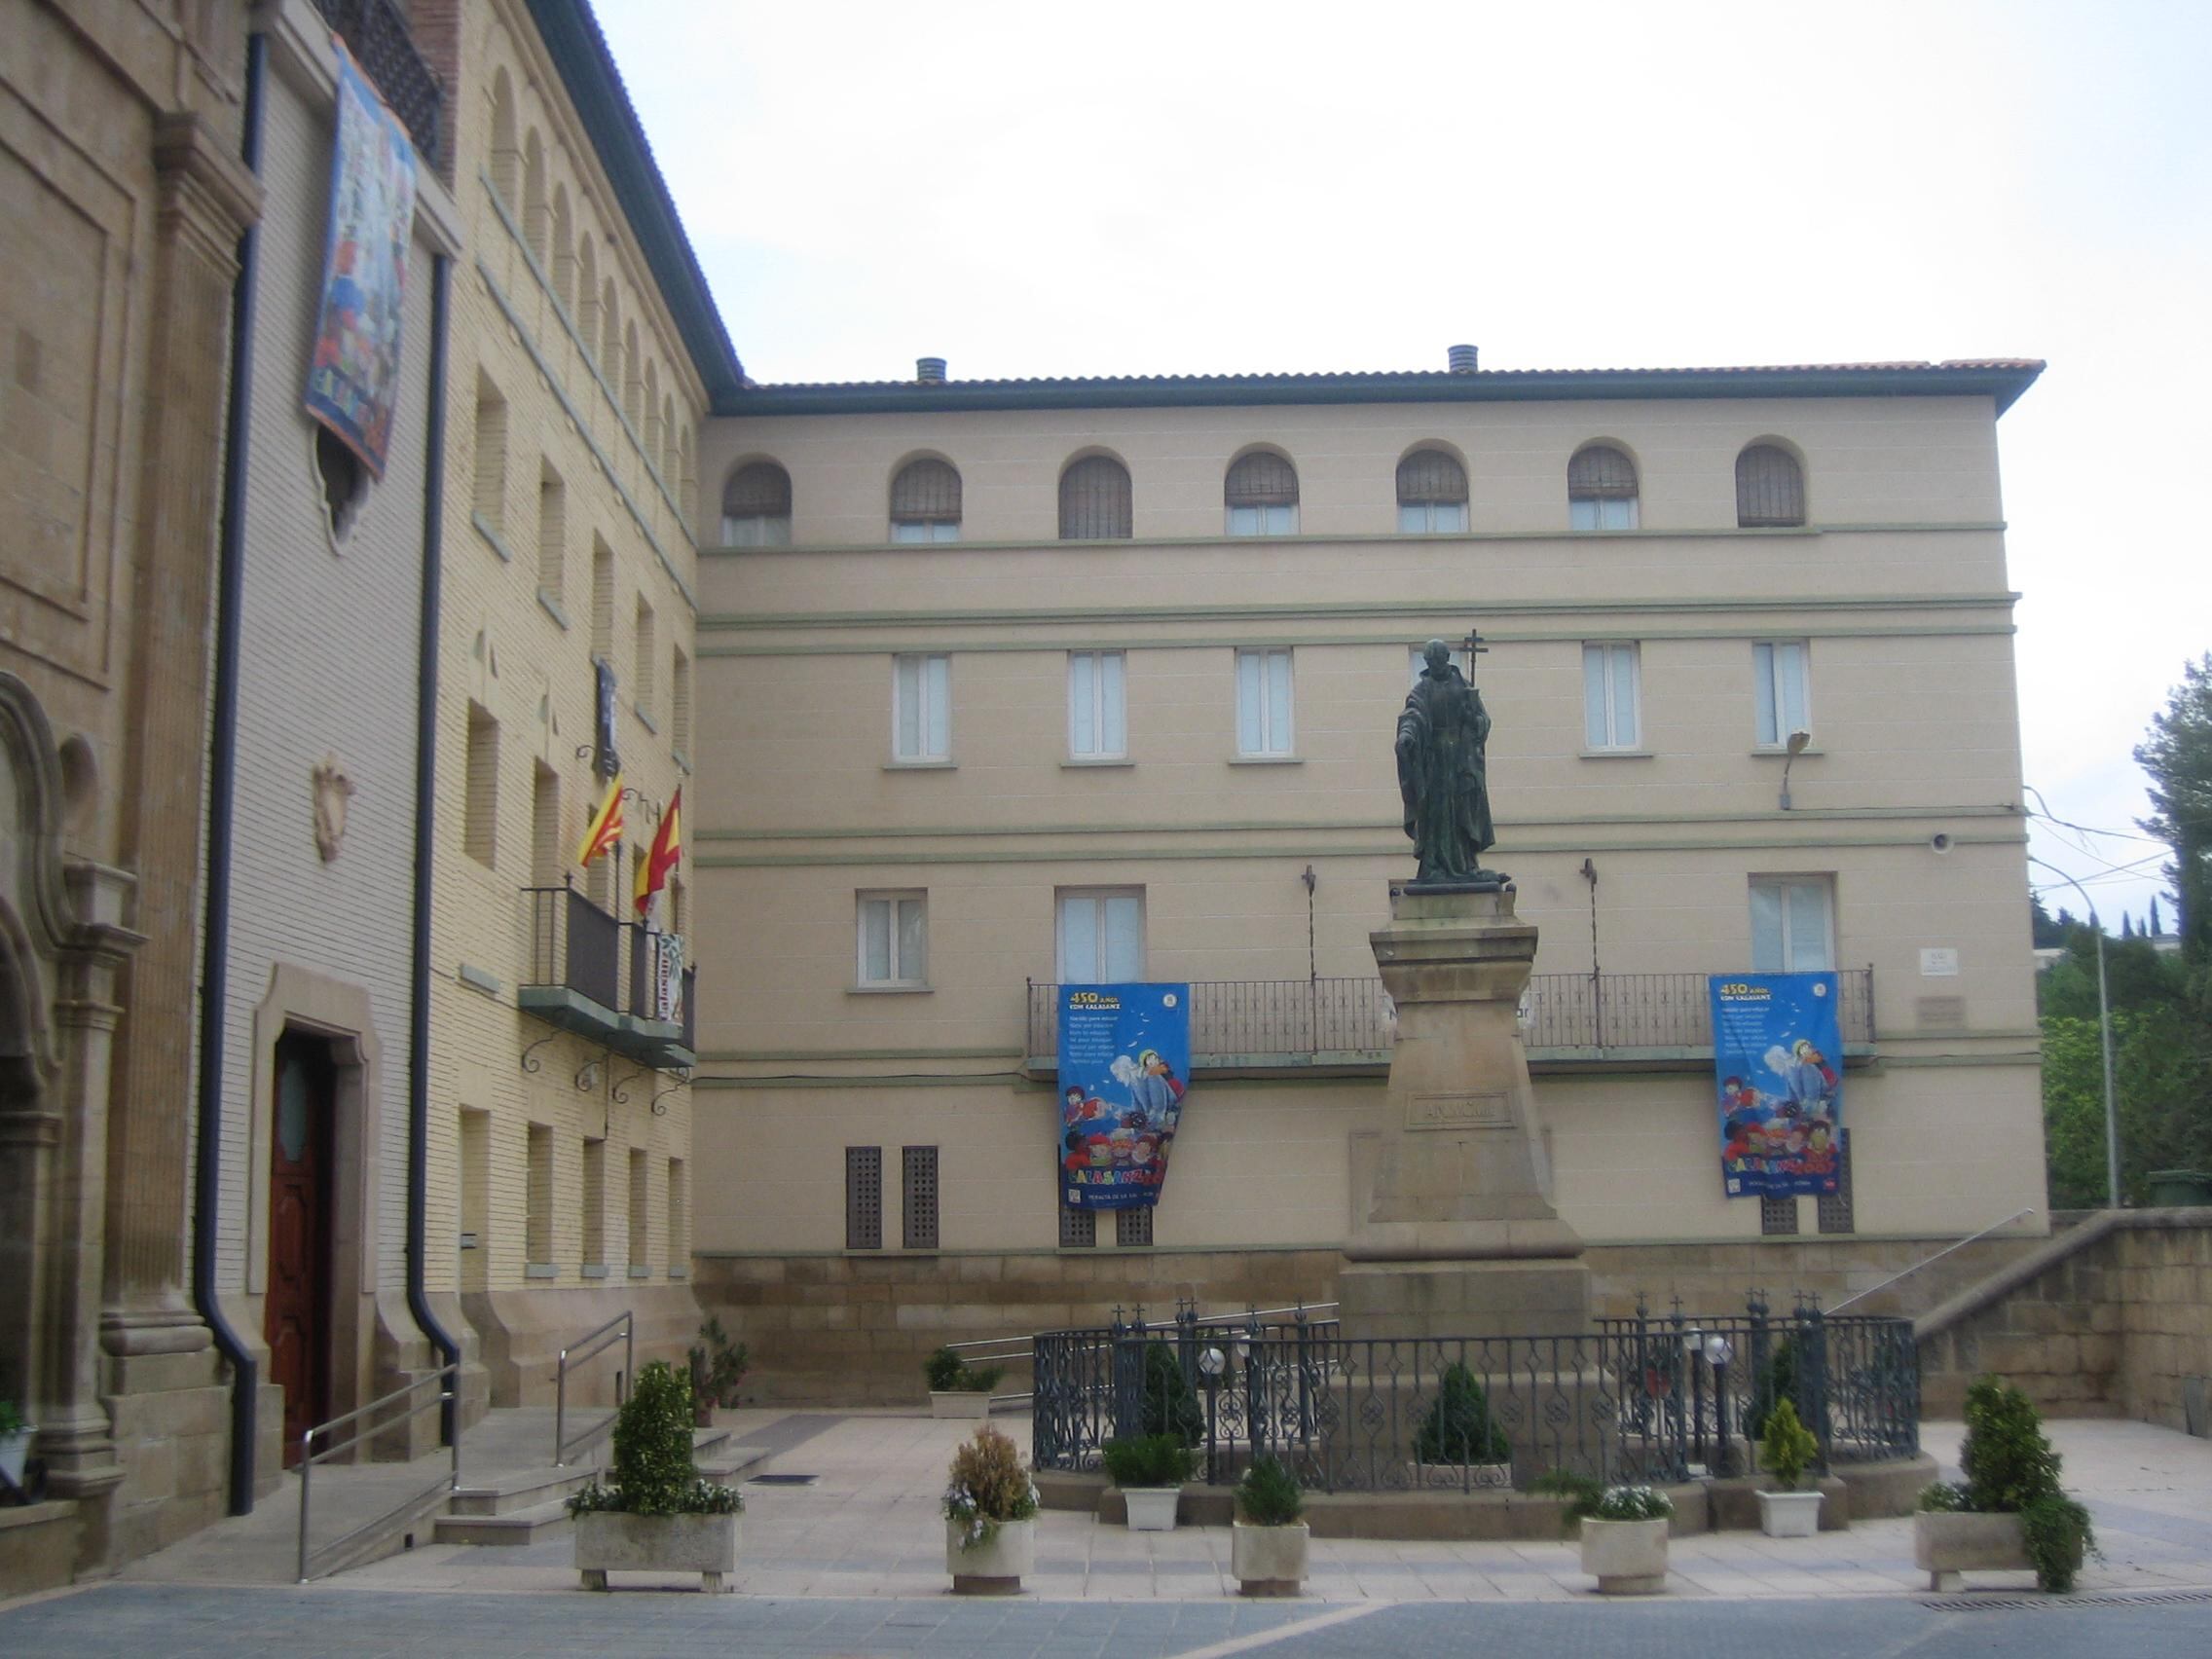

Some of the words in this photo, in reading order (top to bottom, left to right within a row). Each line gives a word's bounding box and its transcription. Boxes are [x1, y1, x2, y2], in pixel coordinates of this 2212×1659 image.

[1721, 984, 1748, 995] 450
[1070, 992, 1098, 1003] 450
[1068, 1168, 1143, 1185] CALASANZ
